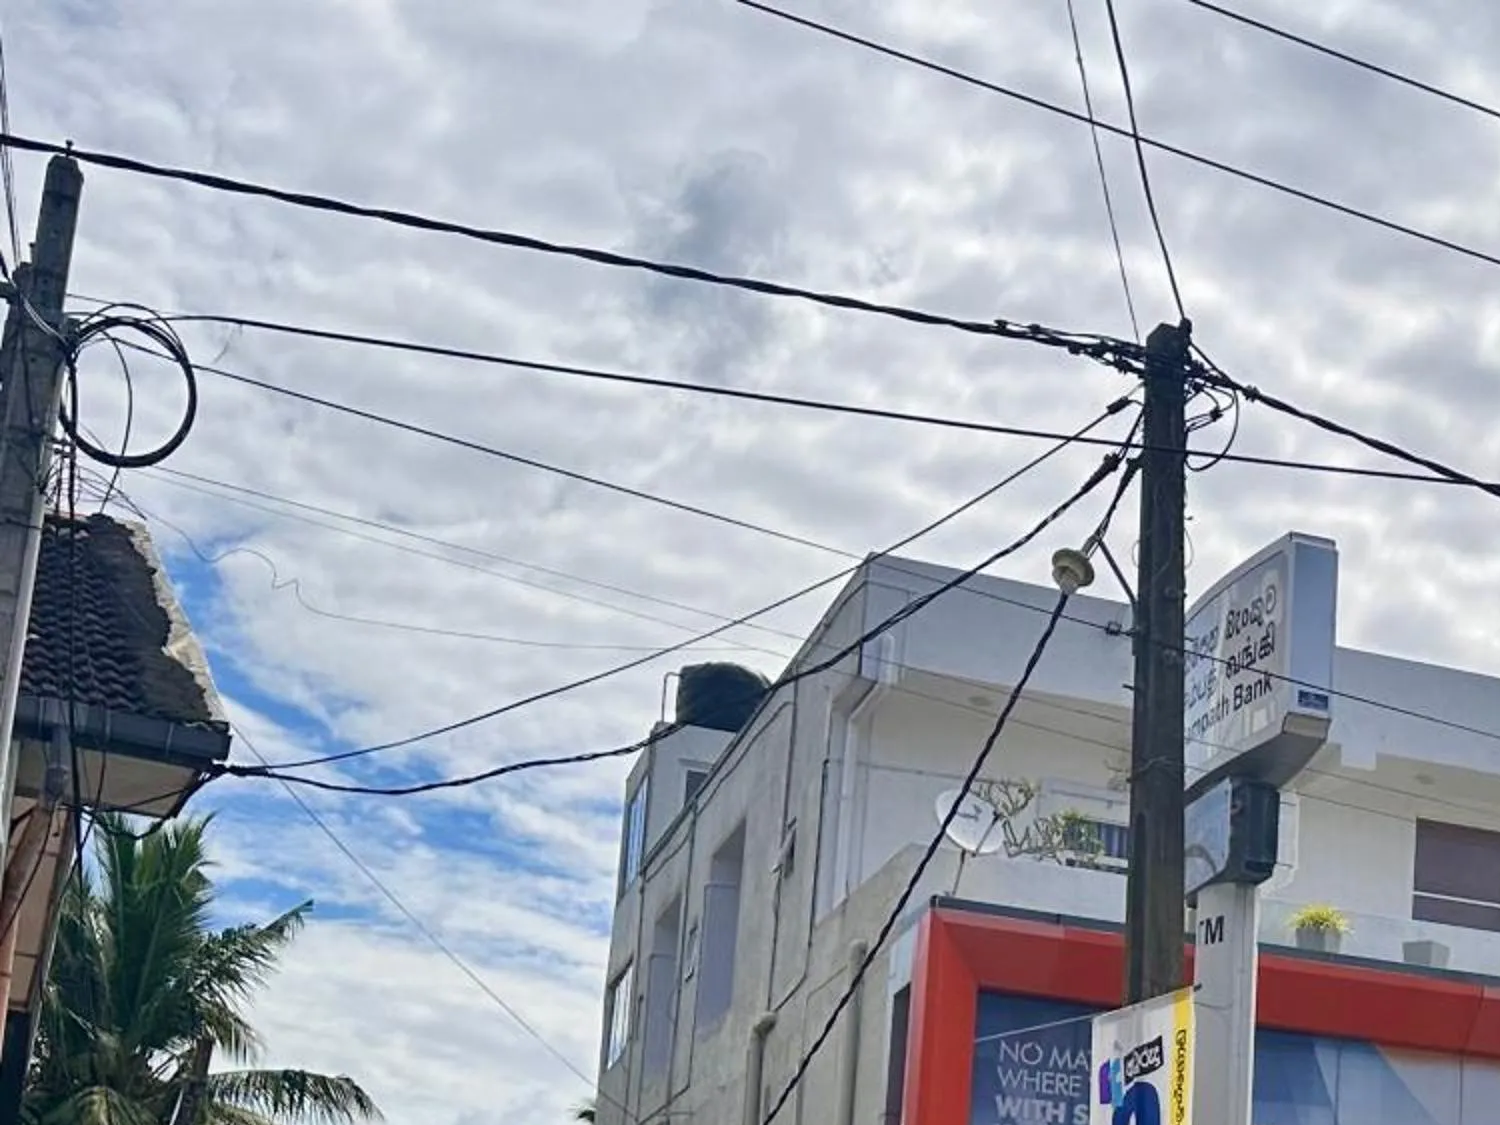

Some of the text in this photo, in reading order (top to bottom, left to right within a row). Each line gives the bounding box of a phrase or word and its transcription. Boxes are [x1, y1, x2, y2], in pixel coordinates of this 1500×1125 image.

[1233, 672, 1273, 712] Bank
[1000, 1041, 1091, 1072] NO MA
[997, 1066, 1082, 1097] WHERE
[995, 1095, 1066, 1125] WITH
